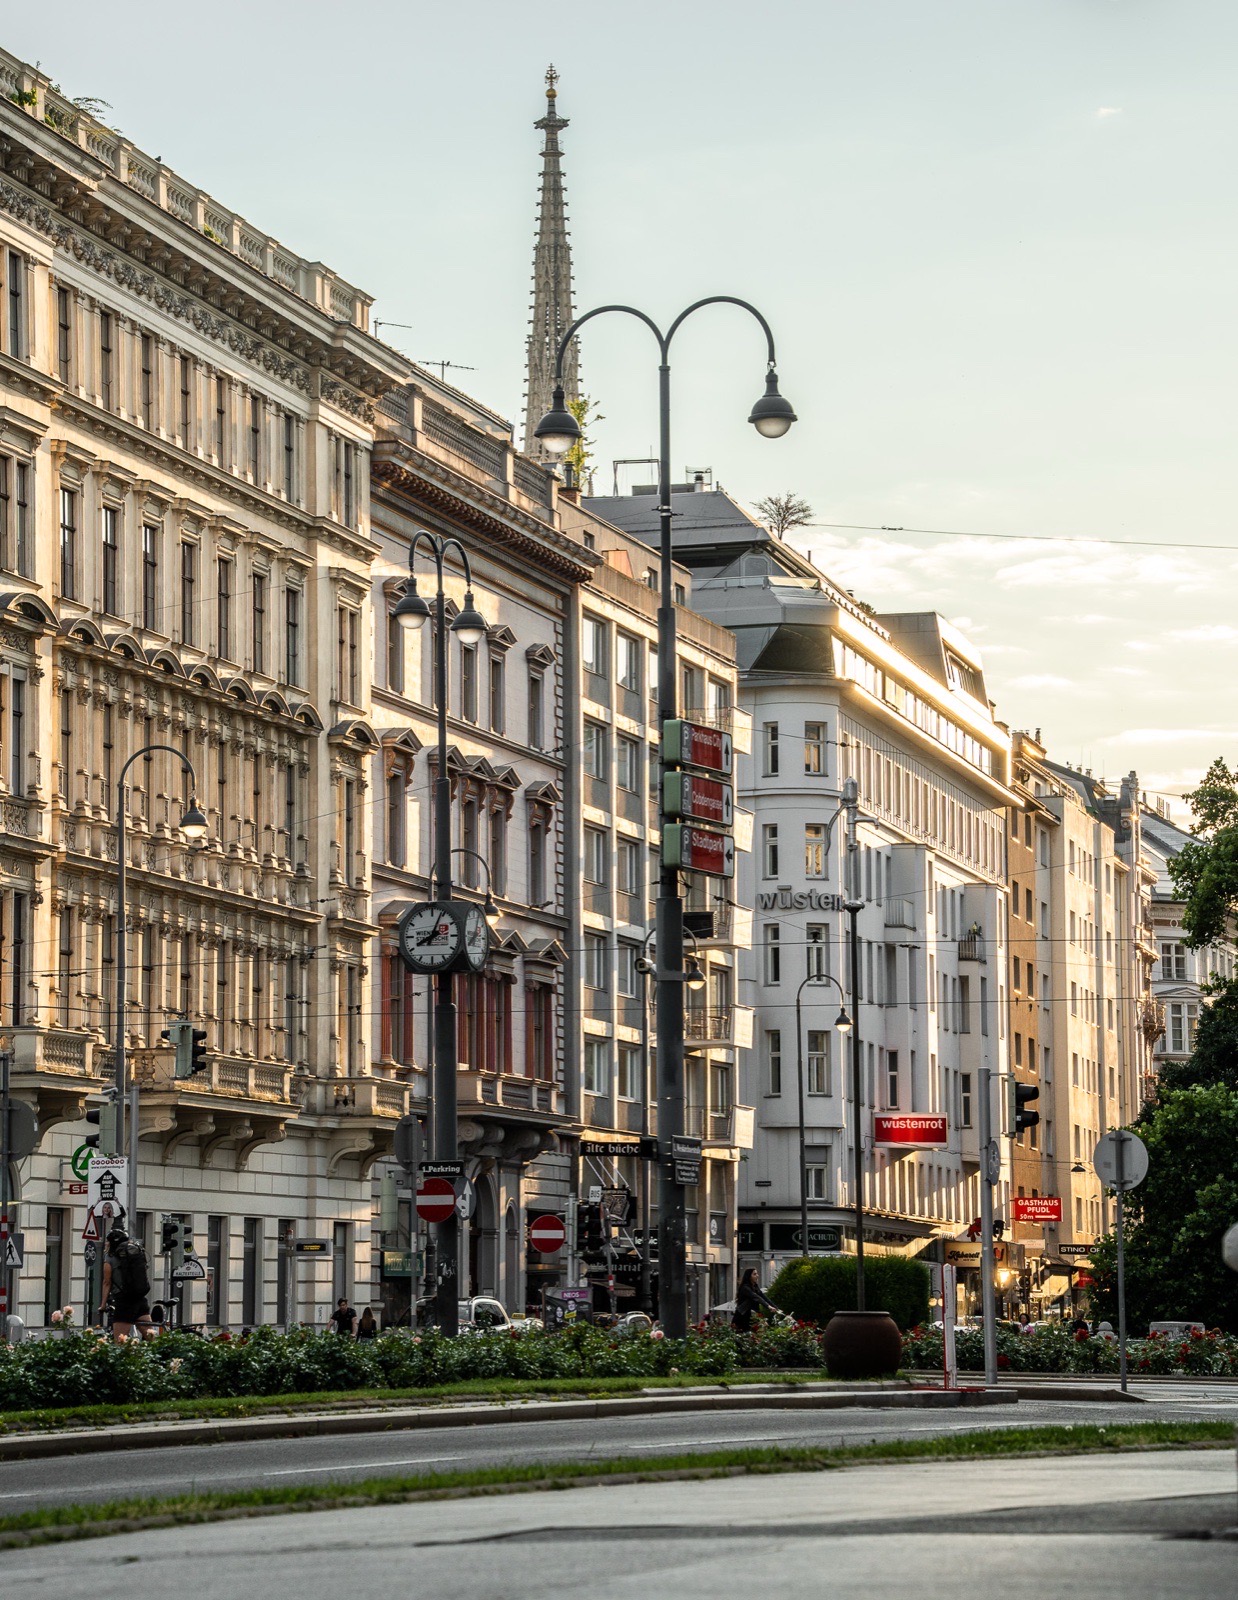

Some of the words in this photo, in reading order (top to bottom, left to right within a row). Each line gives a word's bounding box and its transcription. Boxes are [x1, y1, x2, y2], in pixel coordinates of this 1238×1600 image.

[692, 728, 713, 746] Parkhaus
[713, 733, 723, 751] City
[692, 791, 723, 810] Cobdengasse
[692, 832, 724, 852] Stadtpark
[608, 1144, 640, 1155] büche
[590, 1189, 600, 1198] BUS
